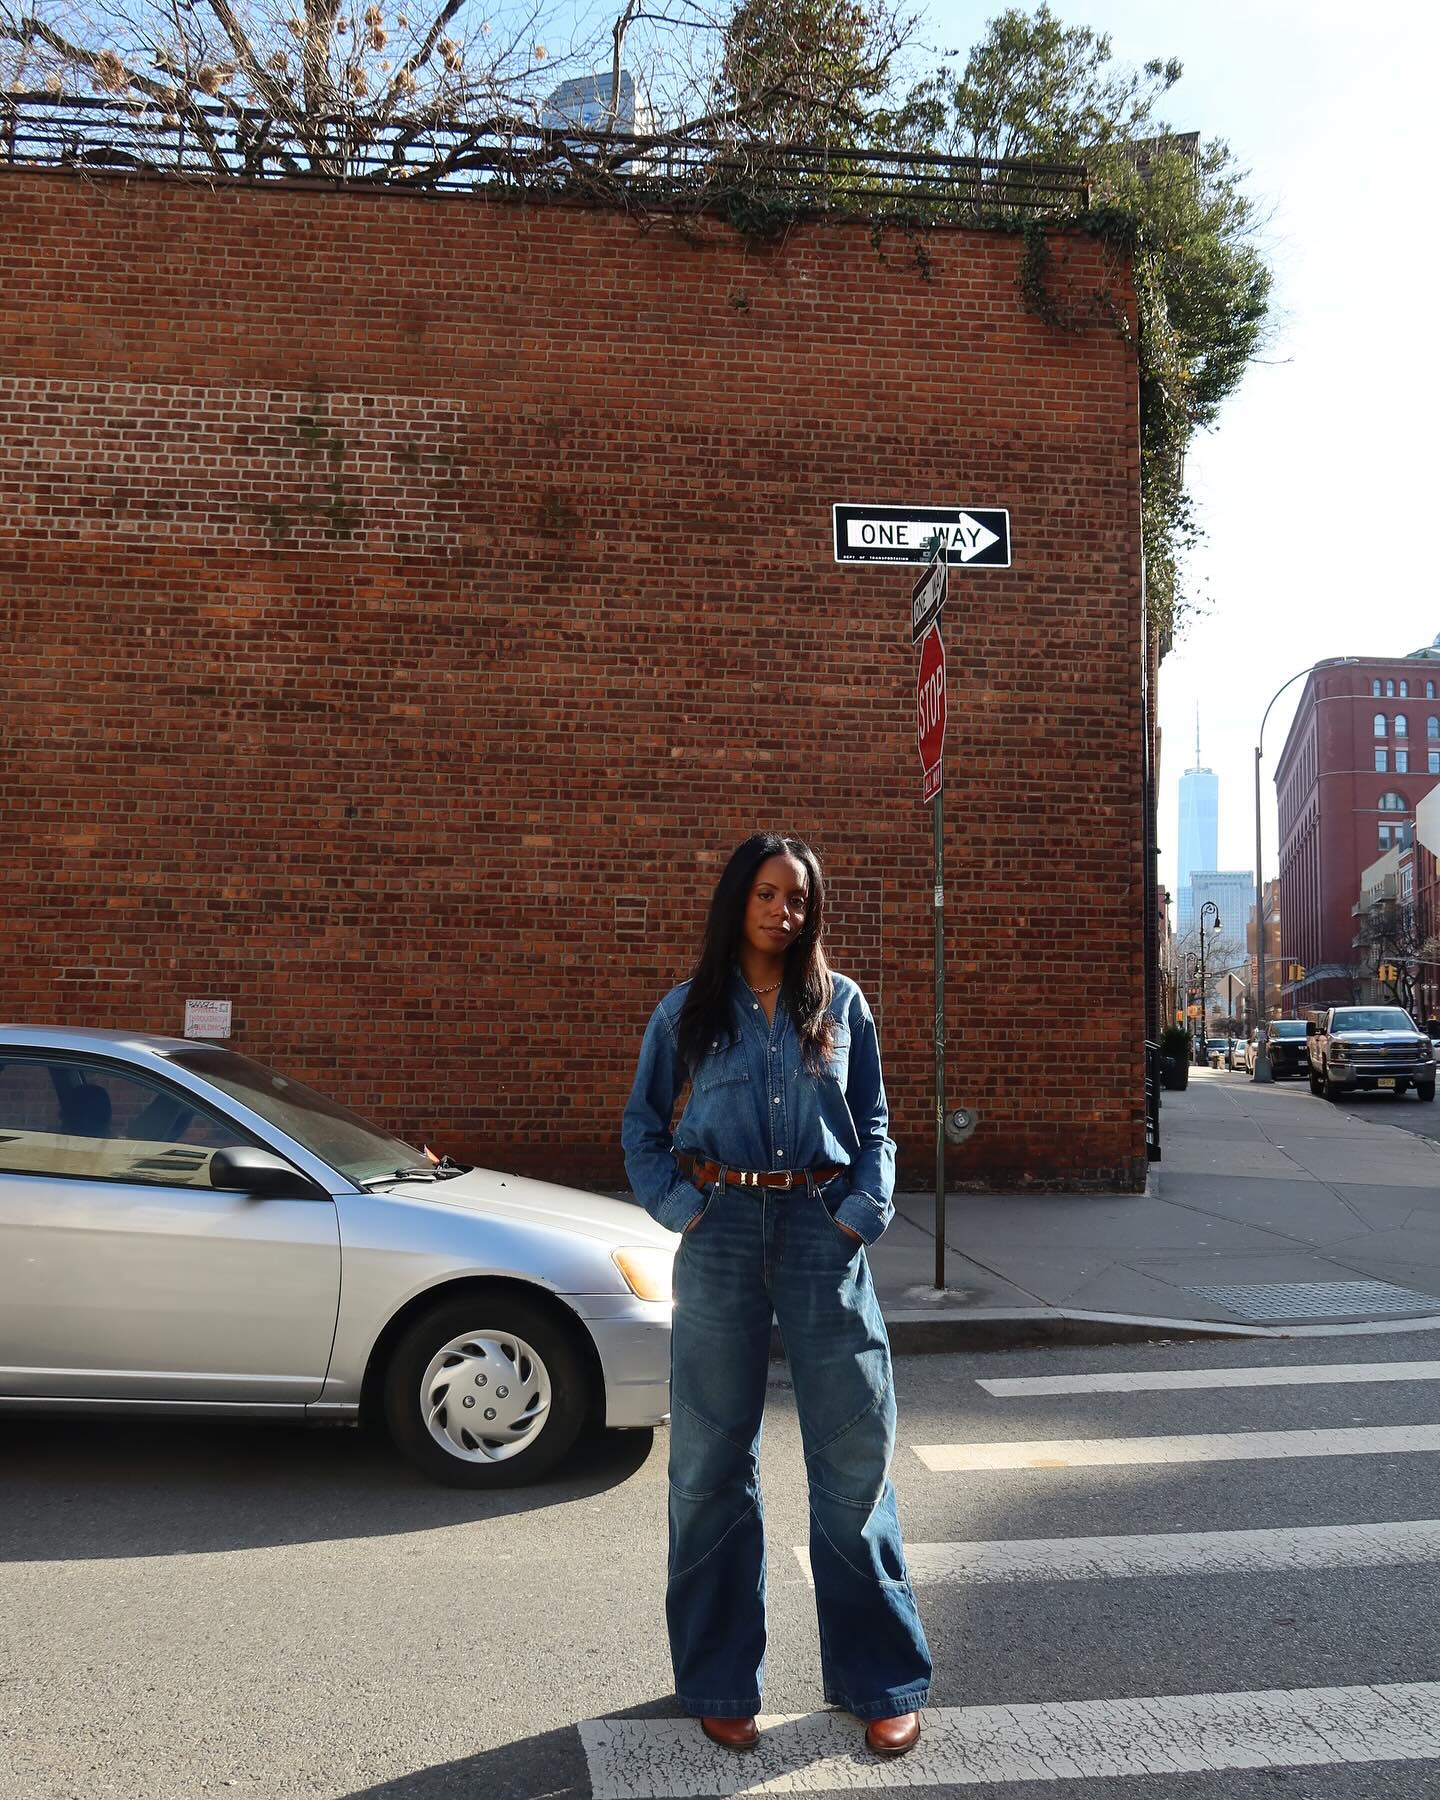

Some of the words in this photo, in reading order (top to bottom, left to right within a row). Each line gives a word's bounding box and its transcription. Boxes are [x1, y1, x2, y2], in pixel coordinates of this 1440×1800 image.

[861, 523, 910, 546] ONE
[933, 526, 981, 548] WAY
[914, 590, 927, 623] ONE
[919, 664, 943, 741] STOP
